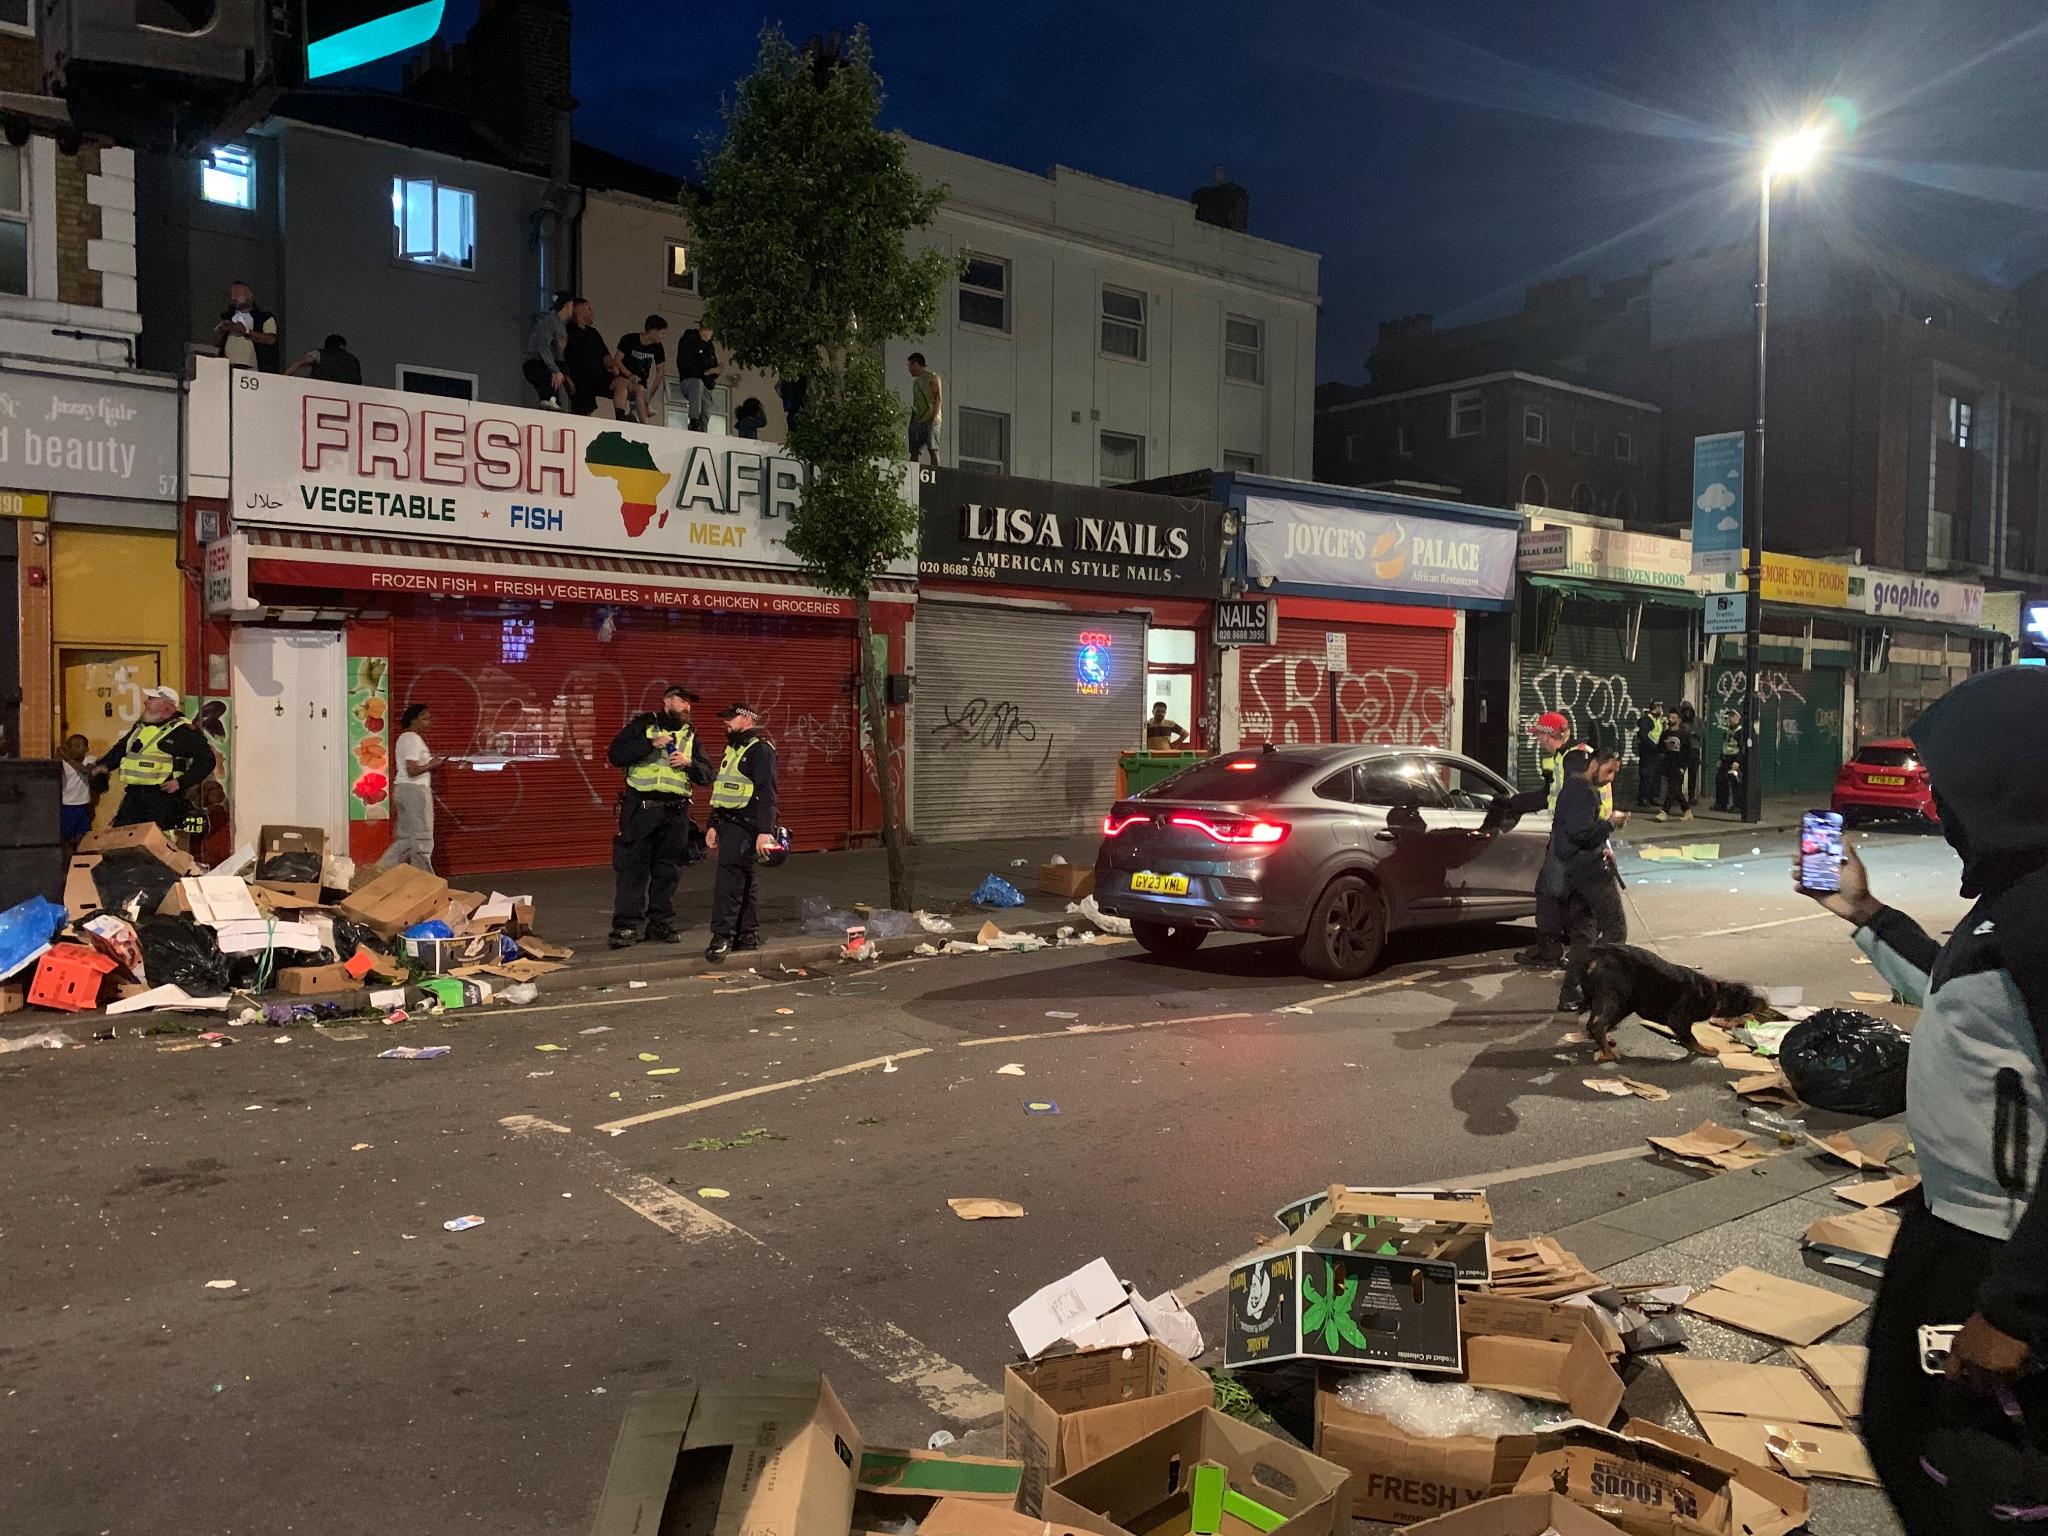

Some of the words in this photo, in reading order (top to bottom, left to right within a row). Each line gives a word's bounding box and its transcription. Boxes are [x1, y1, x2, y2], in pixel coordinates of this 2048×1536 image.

[240, 376, 260, 391] 59
[24, 428, 136, 479] beauty
[301, 395, 577, 497] FRESH
[159, 474, 178, 496] 57
[919, 469, 937, 485] 61
[0, 495, 23, 514] 90
[246, 492, 283, 510] حلال
[300, 485, 456, 522] VEGETABLE
[510, 505, 564, 532] FISH
[689, 522, 747, 548] MEAT
[963, 503, 1064, 549] LISA
[1078, 517, 1190, 560] NAILS
[1411, 537, 1480, 572] PALACE
[919, 561, 940, 574] 020
[942, 563, 969, 577] 8688
[970, 565, 996, 579] 3956
[973, 551, 1064, 574] AMERICAN
[1071, 561, 1120, 579] STYLE
[1127, 564, 1173, 583] NAILS
[1410, 570, 1440, 584] African
[1612, 565, 1651, 584] FROZEN
[1652, 571, 1686, 586] FOODS
[1792, 567, 1817, 588] SPICY
[1818, 572, 1846, 592] FOODS
[371, 573, 438, 590] FROZEN
[442, 577, 477, 593] FISH
[494, 581, 545, 597] FRESH
[548, 584, 640, 603] VEGETABLES
[653, 591, 689, 606] MEAT
[692, 594, 702, 606] &
[703, 595, 760, 610] CHICKEN
[771, 599, 841, 615] GROCERIES
[1873, 579, 1940, 613] graphico
[1219, 604, 1267, 628] NAILS
[1079, 631, 1112, 647] OPEN
[1135, 875, 1162, 890] GY23
[1163, 877, 1184, 892] VML
[1397, 1351, 1425, 1361] Colombia
[1425, 1354, 1432, 1362] of
[1432, 1354, 1456, 1364] Product
[1366, 1472, 1458, 1510] FRESH
[1590, 1471, 1663, 1507] FOODS
[1393, 1511, 1427, 1524] PROD
